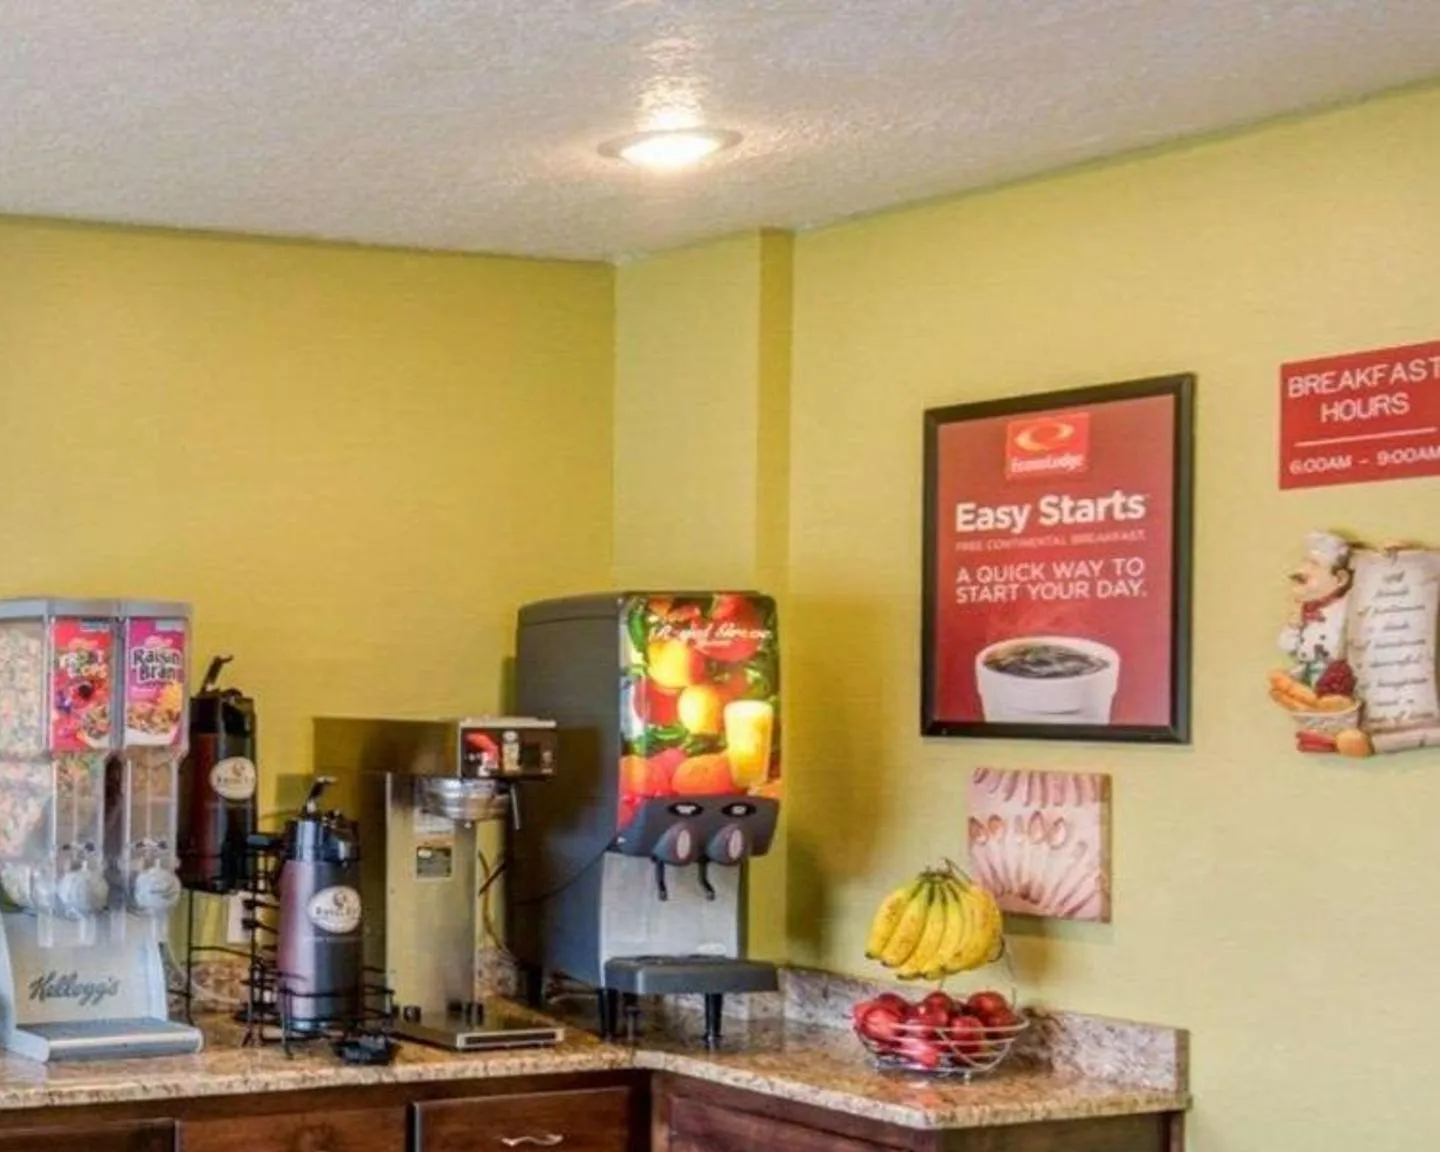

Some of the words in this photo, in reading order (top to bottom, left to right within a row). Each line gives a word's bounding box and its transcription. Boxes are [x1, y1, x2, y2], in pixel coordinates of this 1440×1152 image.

[1287, 356, 1440, 398] BREAKFAST
[1320, 391, 1410, 423] HOURS
[956, 503, 1032, 535] Easy
[1038, 489, 1146, 527] Starts
[957, 567, 971, 584] A
[976, 562, 1046, 584] QUICK
[1052, 559, 1105, 579] WAY
[1113, 556, 1145, 577] TO
[956, 583, 1020, 605] START
[1026, 580, 1091, 601] YOUR
[1097, 578, 1148, 599] DAY.
[140, 664, 177, 683] Bran
[28, 968, 121, 1006] Kellogg's
